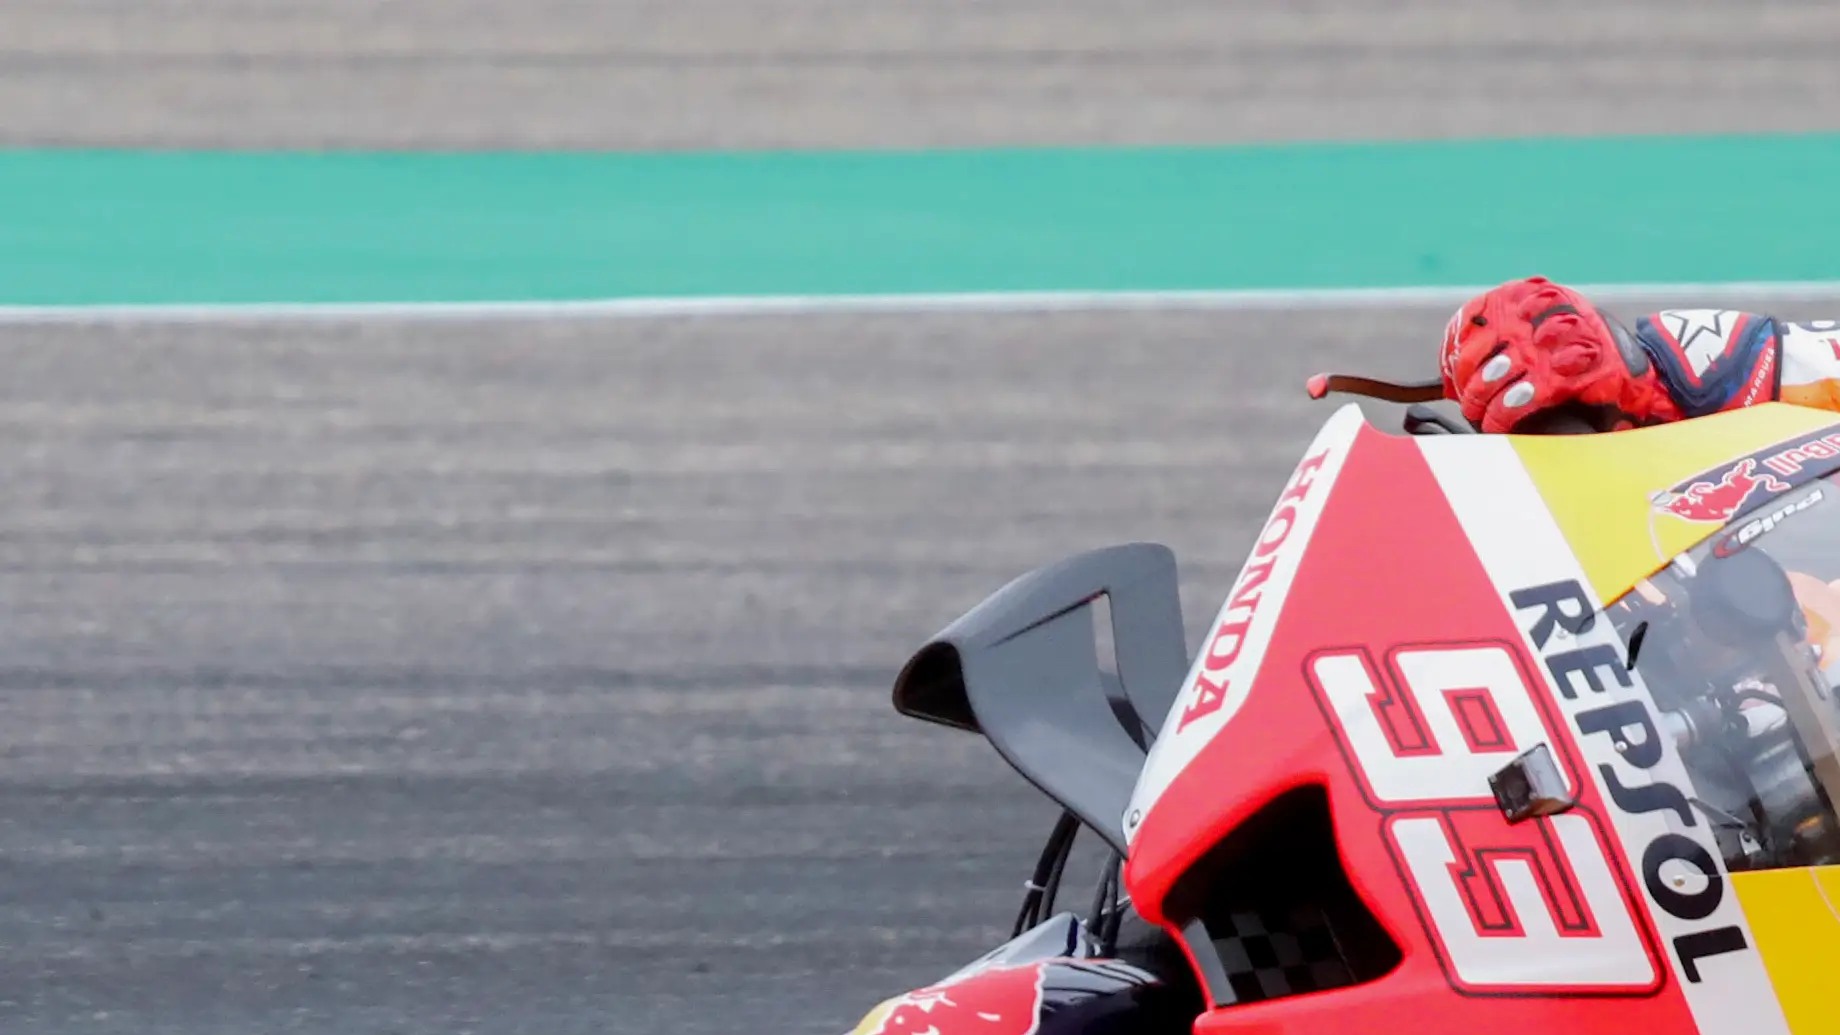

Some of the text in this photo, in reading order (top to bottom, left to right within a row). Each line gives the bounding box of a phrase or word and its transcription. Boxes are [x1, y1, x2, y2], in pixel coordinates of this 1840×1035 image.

[1176, 447, 1330, 735] HONDA
[1308, 643, 1663, 990] 93
[1509, 578, 1748, 984] REPSOL
